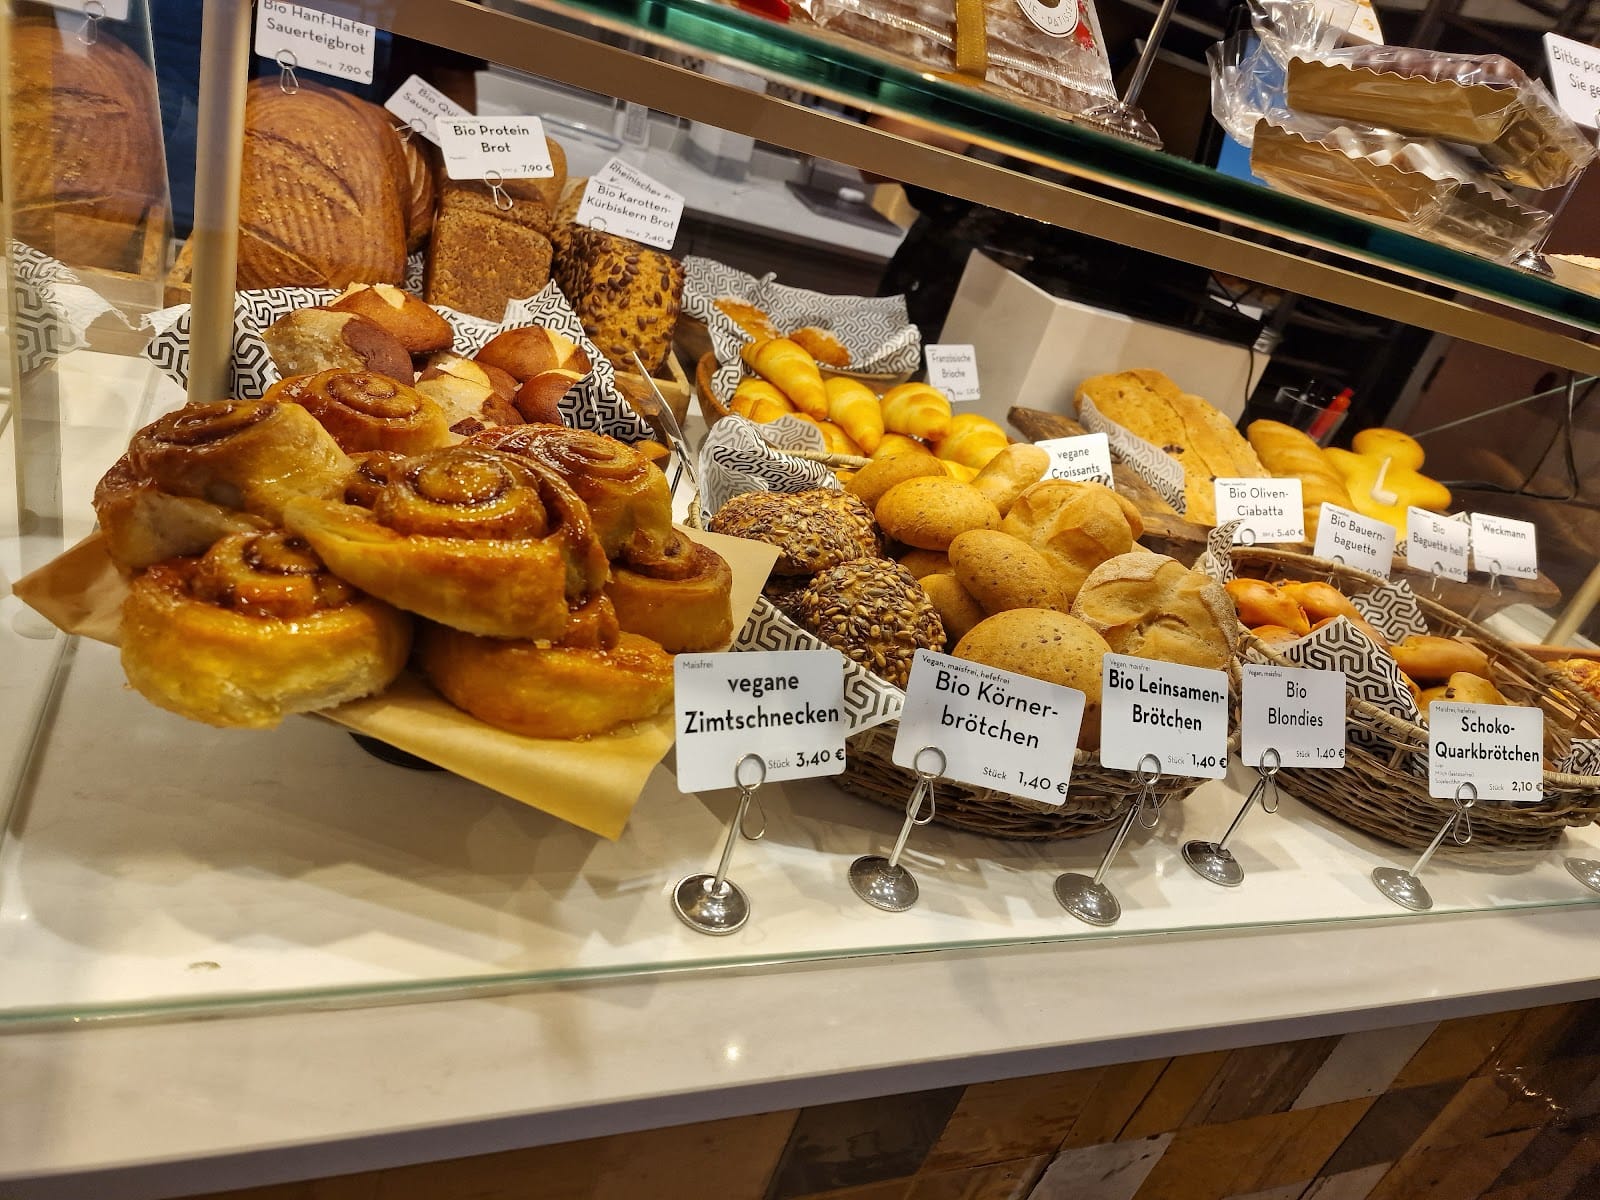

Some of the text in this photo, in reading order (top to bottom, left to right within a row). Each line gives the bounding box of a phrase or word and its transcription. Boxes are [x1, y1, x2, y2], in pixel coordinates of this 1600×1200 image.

[263, 0, 370, 38] Bio Hanf-Hafer
[266, 17, 365, 55] Sauerteigbrot
[1552, 45, 1580, 66] Bitte
[365, 70, 373, 78] €
[1569, 73, 1587, 91] Sie
[418, 87, 437, 104] Bio
[453, 125, 476, 136] Bio
[479, 124, 530, 136] Protein
[481, 142, 512, 153] Brot
[545, 164, 553, 172] €
[597, 185, 671, 214] Bio Karotten-
[587, 196, 674, 230] Kürbiskern Brot
[1057, 448, 1090, 462] vegane
[1051, 463, 1101, 480] Croissants
[1229, 487, 1289, 499] Bio Oliven-
[1237, 504, 1284, 516] Ciabatta
[1330, 513, 1386, 541] Bio Bauern-
[1433, 522, 1445, 535] Bio
[1482, 522, 1526, 539] Weckmann
[1334, 531, 1377, 556] baguette
[1413, 532, 1448, 553] Baguette
[1450, 543, 1464, 556] hell
[682, 660, 713, 670] Maisfrei
[922, 654, 1010, 684] Vegan, maisfrei, hefefrei
[727, 675, 799, 698] vegane
[935, 670, 1059, 718] Bio Körner-
[1109, 668, 1225, 703] Bio Leinsamen-
[1286, 681, 1307, 698] Bio
[684, 702, 839, 734] Zimtschnecken
[1132, 704, 1202, 731] Brötchen
[1268, 707, 1323, 726] Blondies
[1461, 716, 1515, 734] Schoko-
[941, 704, 1040, 749] brötchen
[768, 748, 845, 769] Stück 3,40 €
[1167, 754, 1227, 768] Stück 1,40 €
[1296, 750, 1310, 758] Stück
[1338, 749, 1345, 758] €
[1435, 741, 1540, 762] Quarkbrötchen
[983, 766, 1068, 795] Stück 1,40 €
[1489, 781, 1543, 793] Stück 2,10 €
